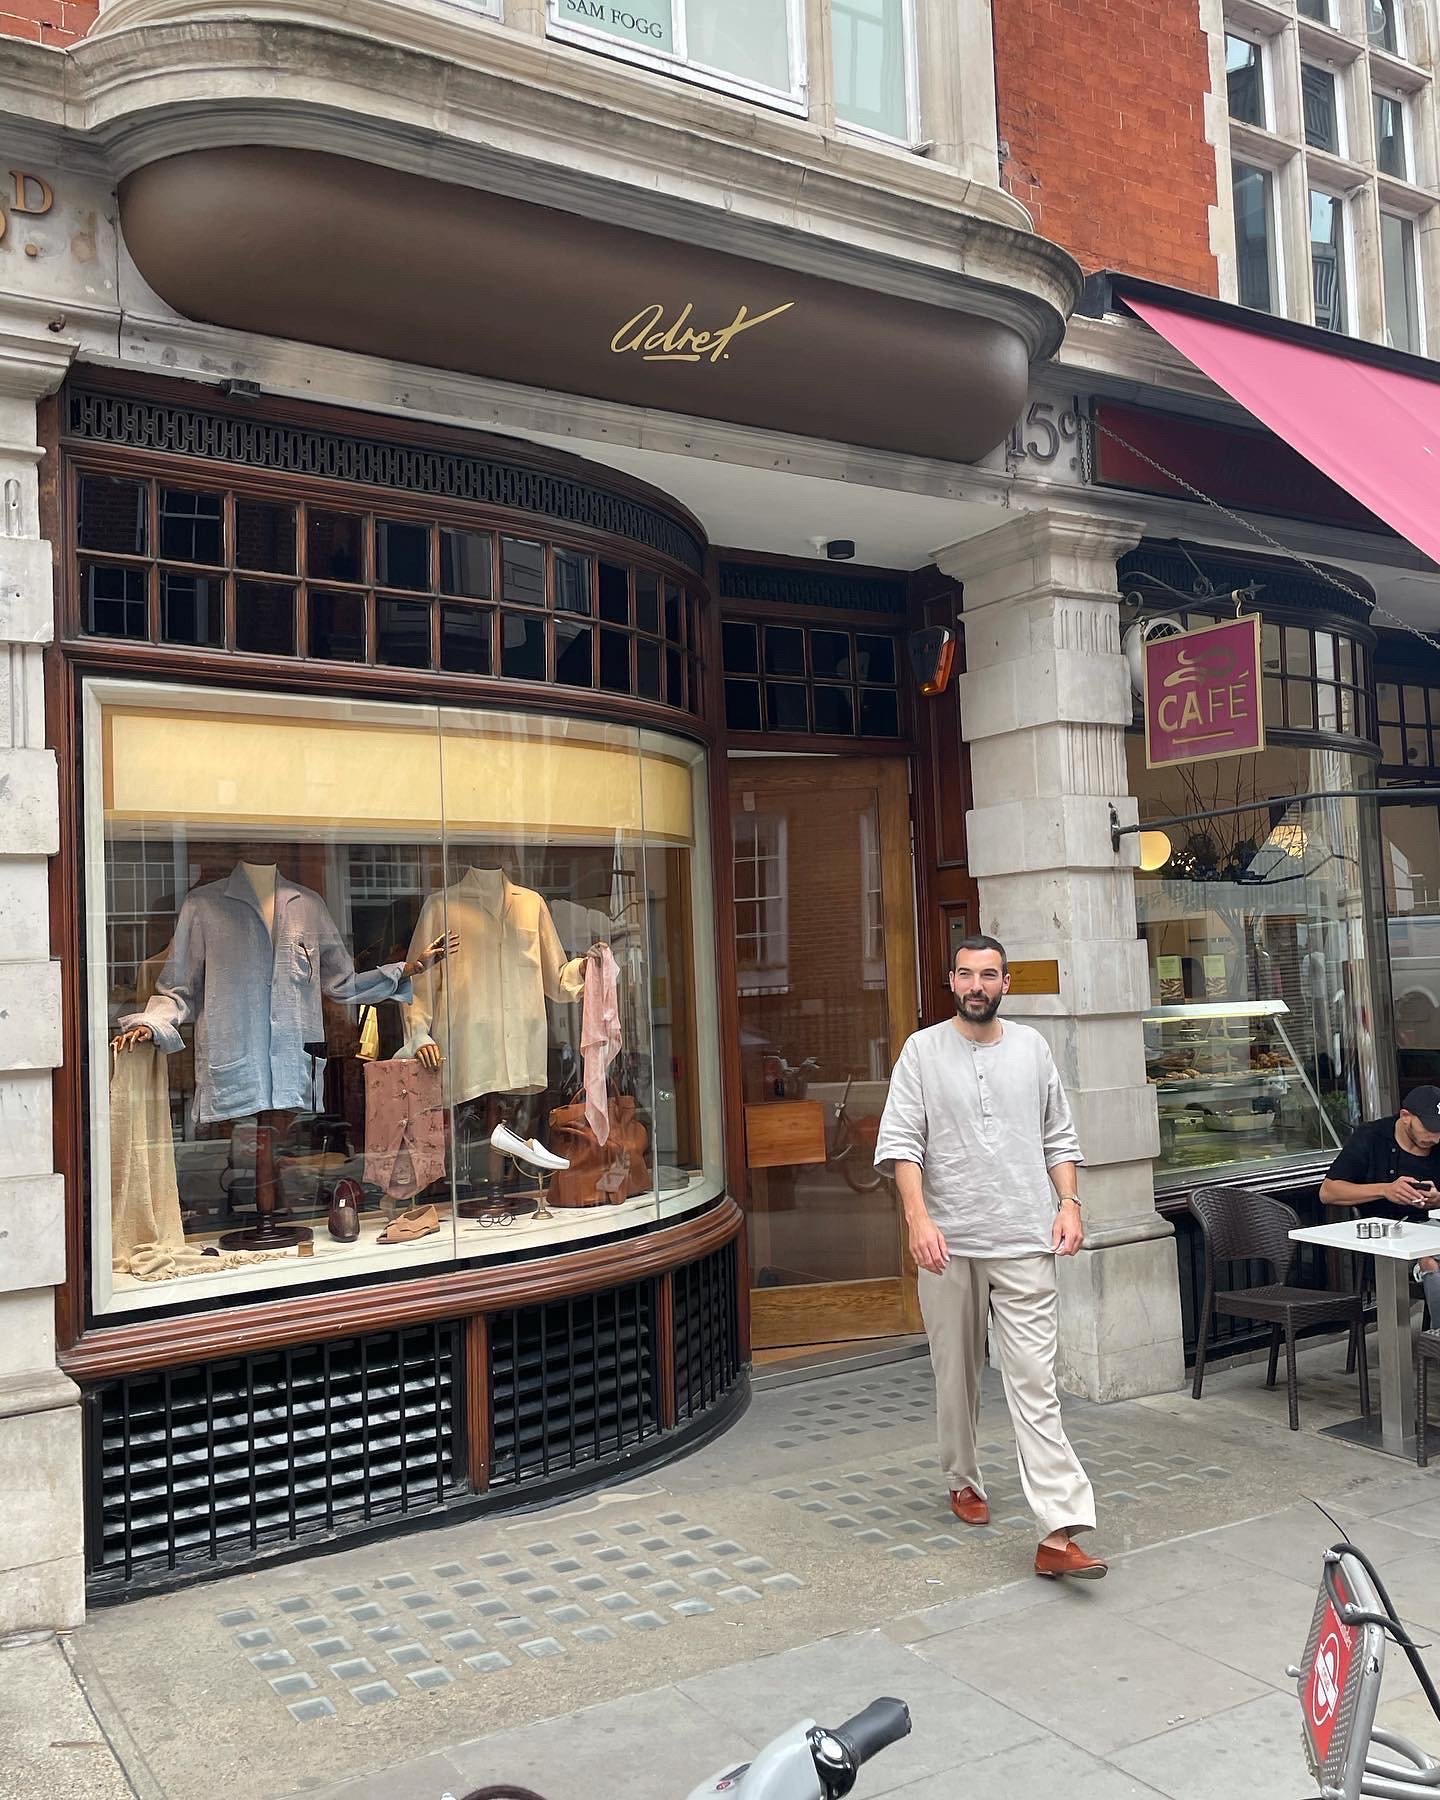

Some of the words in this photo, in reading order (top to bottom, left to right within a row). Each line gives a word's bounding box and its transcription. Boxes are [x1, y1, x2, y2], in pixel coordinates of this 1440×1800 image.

[567, 0, 605, 20] SAM
[611, 8, 663, 38] FOGG
[1157, 669, 1249, 733] CAFÉ
